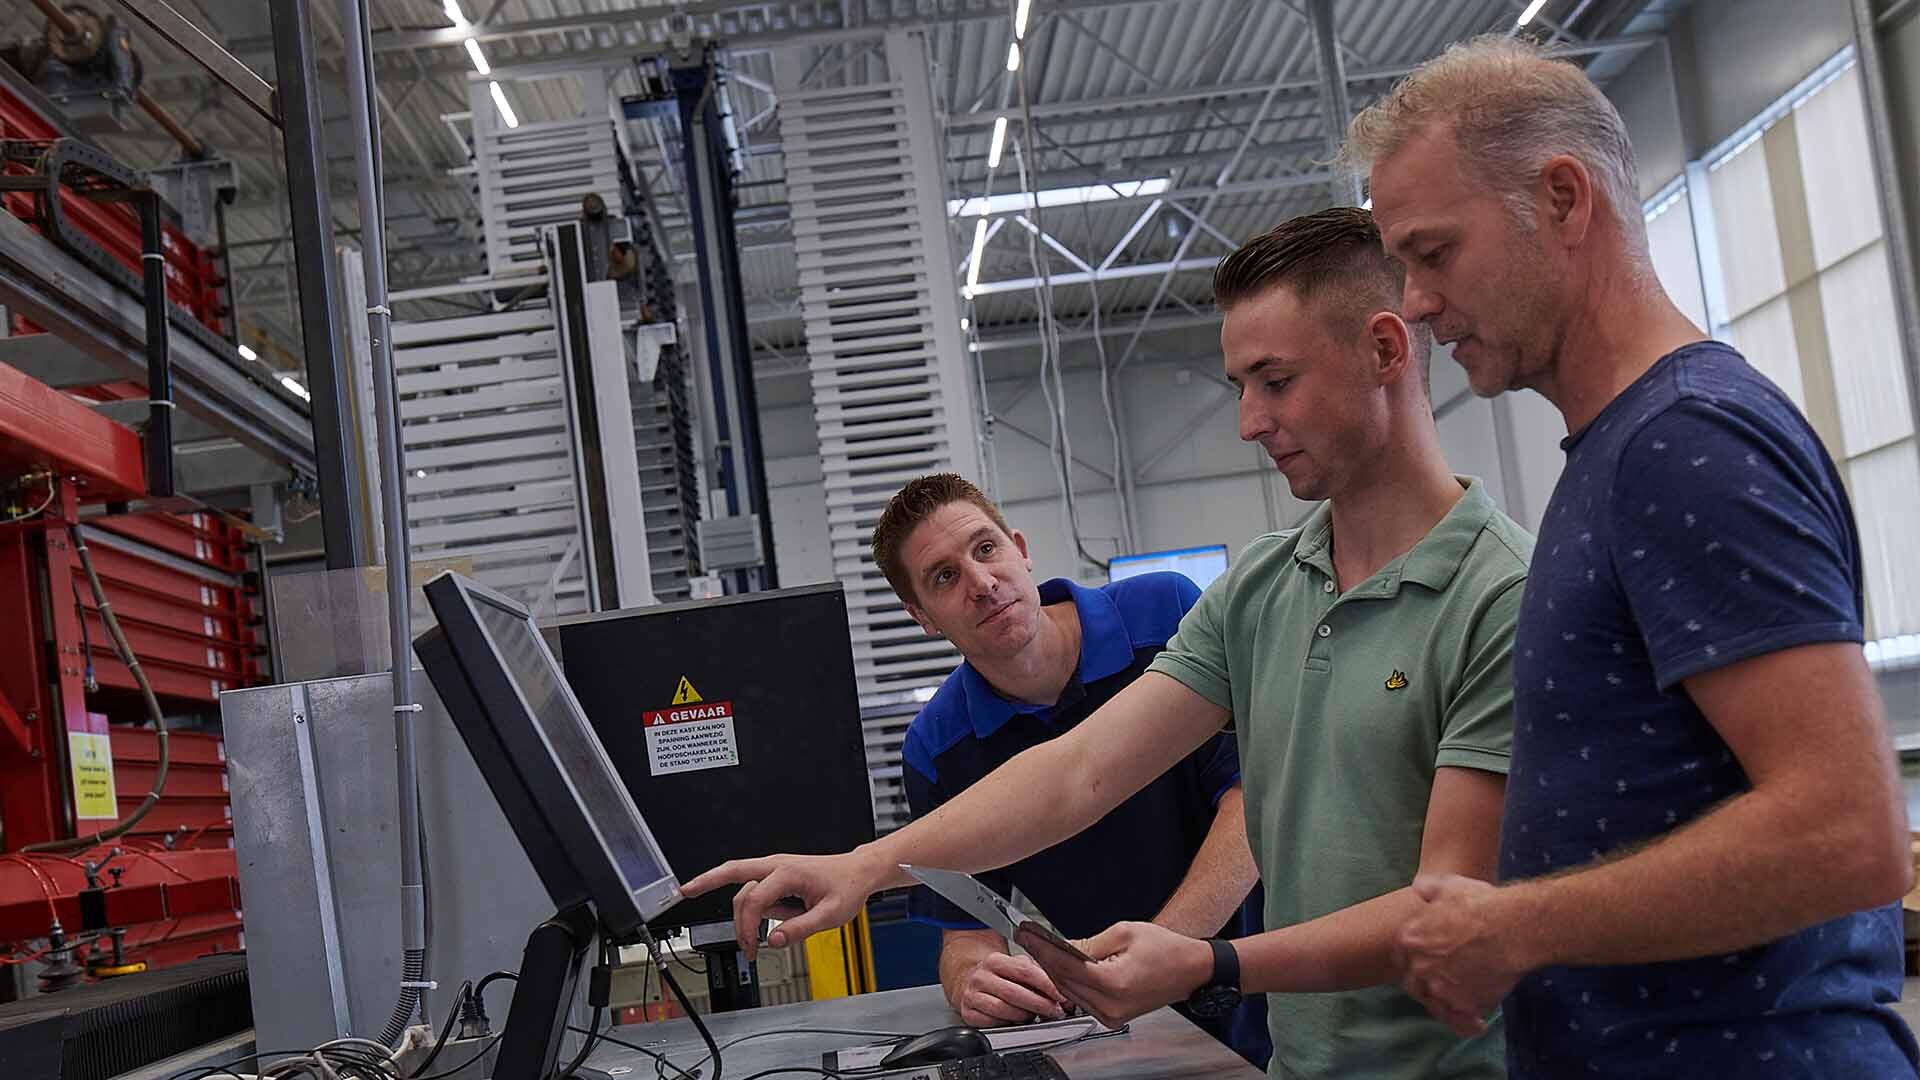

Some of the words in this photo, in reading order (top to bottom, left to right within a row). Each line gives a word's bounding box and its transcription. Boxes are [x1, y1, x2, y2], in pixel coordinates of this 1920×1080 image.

[670, 706, 726, 722] GEVAAR
[658, 735, 690, 744] SPANNING
[691, 731, 724, 740] AANWEZIG
[687, 740, 718, 748] WANNEER
[657, 747, 721, 760] HOOFDSCHAKELAAR
